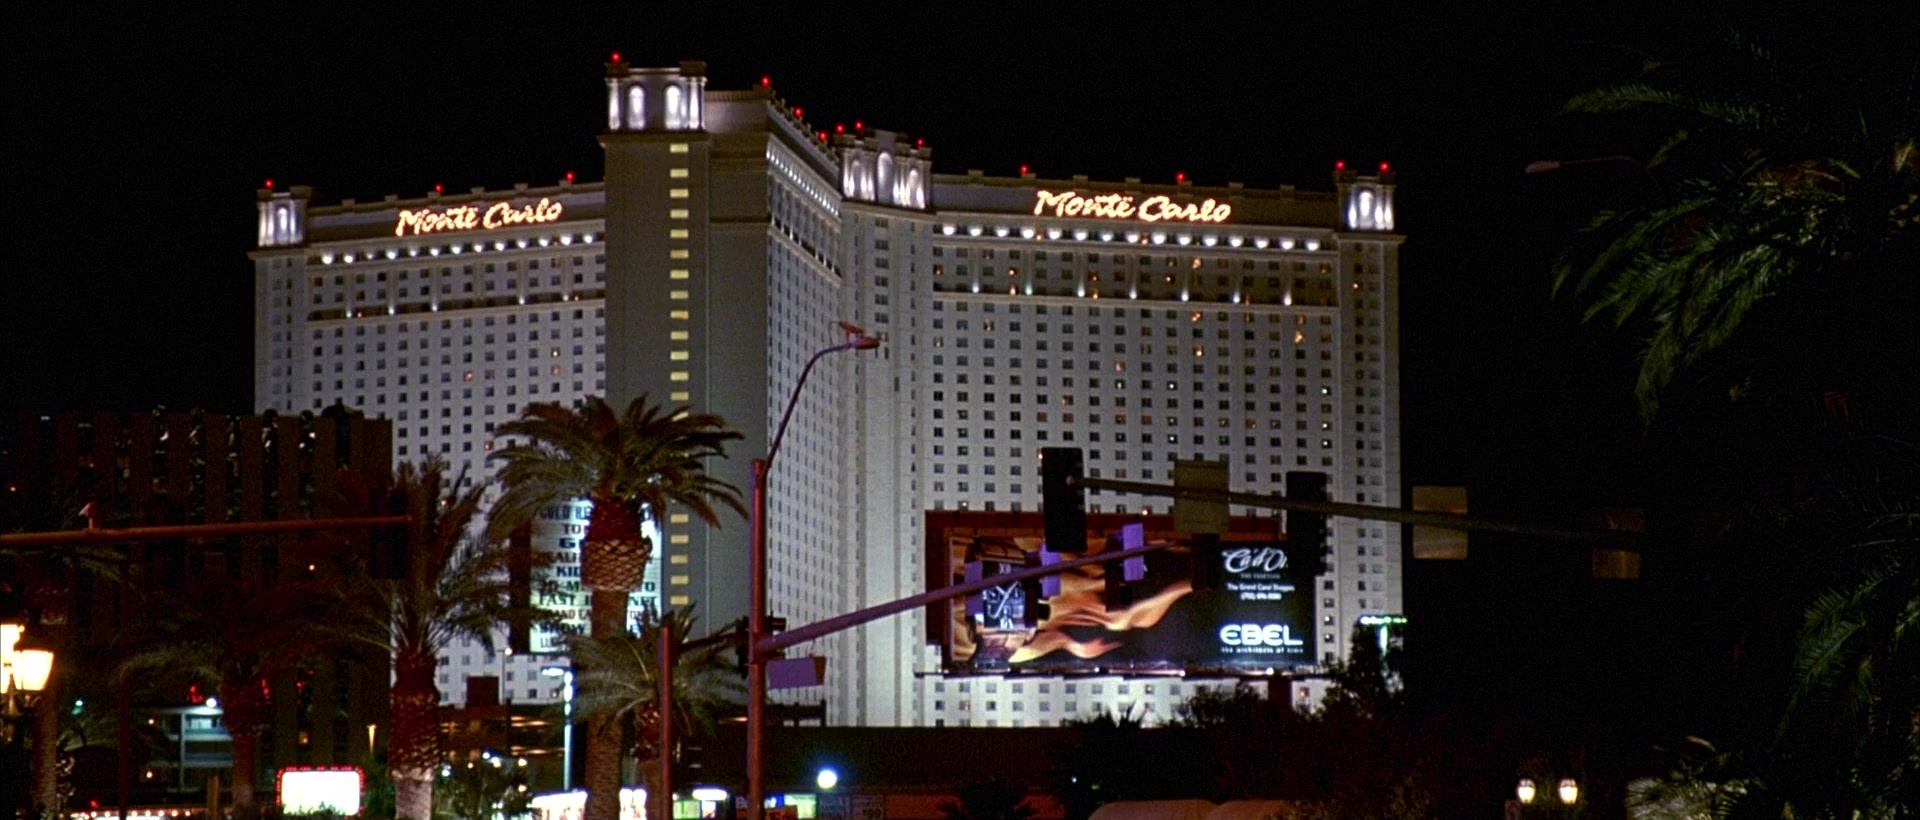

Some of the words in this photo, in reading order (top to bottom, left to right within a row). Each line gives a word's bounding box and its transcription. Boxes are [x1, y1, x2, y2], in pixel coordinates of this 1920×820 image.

[482, 198, 563, 230] Carlo
[1138, 195, 1231, 222] Carlo
[1220, 624, 1304, 647] EBEL
